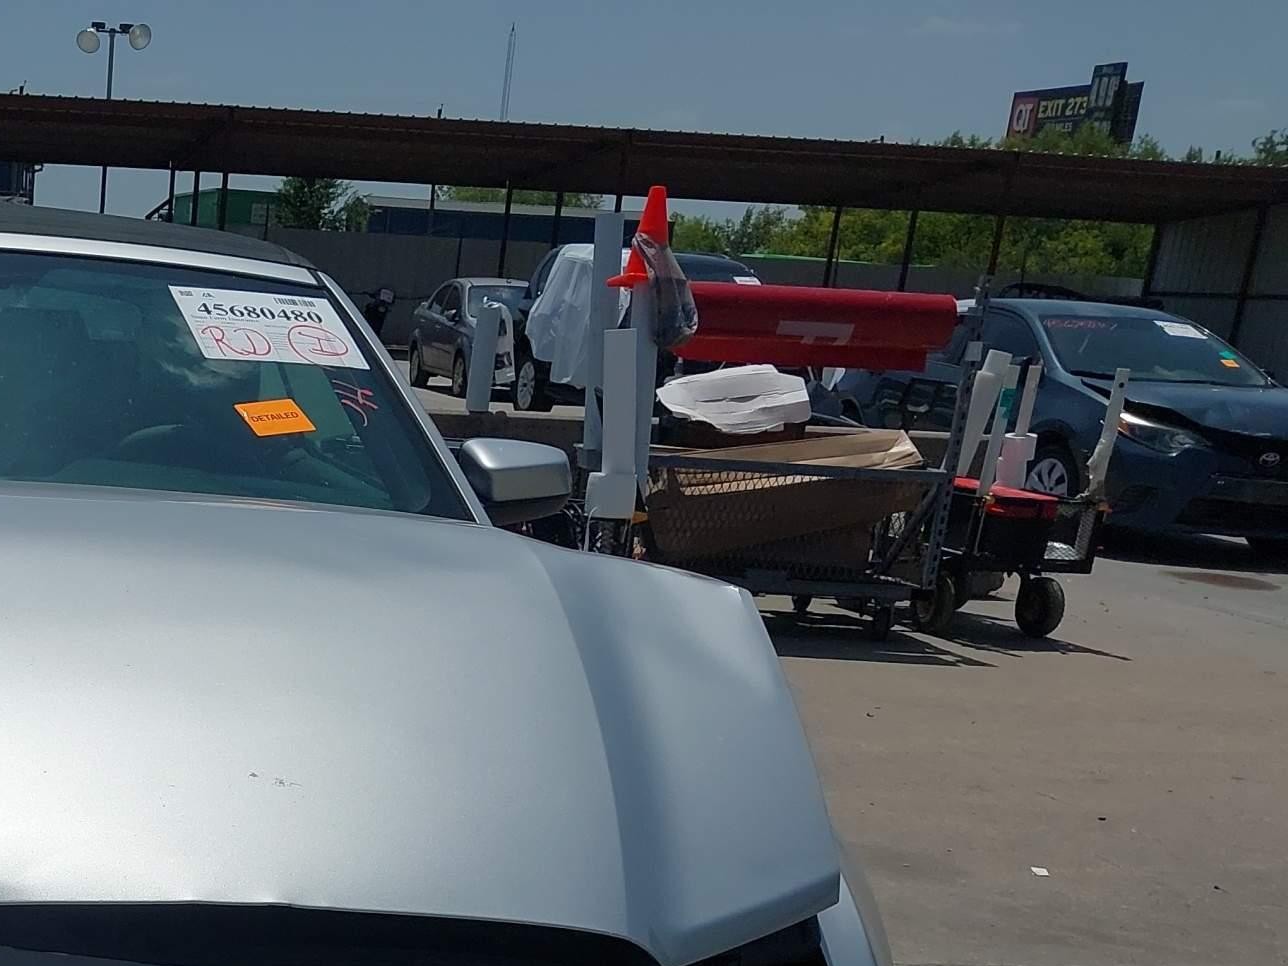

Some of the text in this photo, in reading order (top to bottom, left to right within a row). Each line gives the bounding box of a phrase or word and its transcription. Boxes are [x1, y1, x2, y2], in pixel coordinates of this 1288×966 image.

[1037, 96, 1088, 118] EXIT 273
[1014, 104, 1033, 133] QT
[197, 302, 323, 324] 45680480
[251, 411, 300, 422] DETAILED
